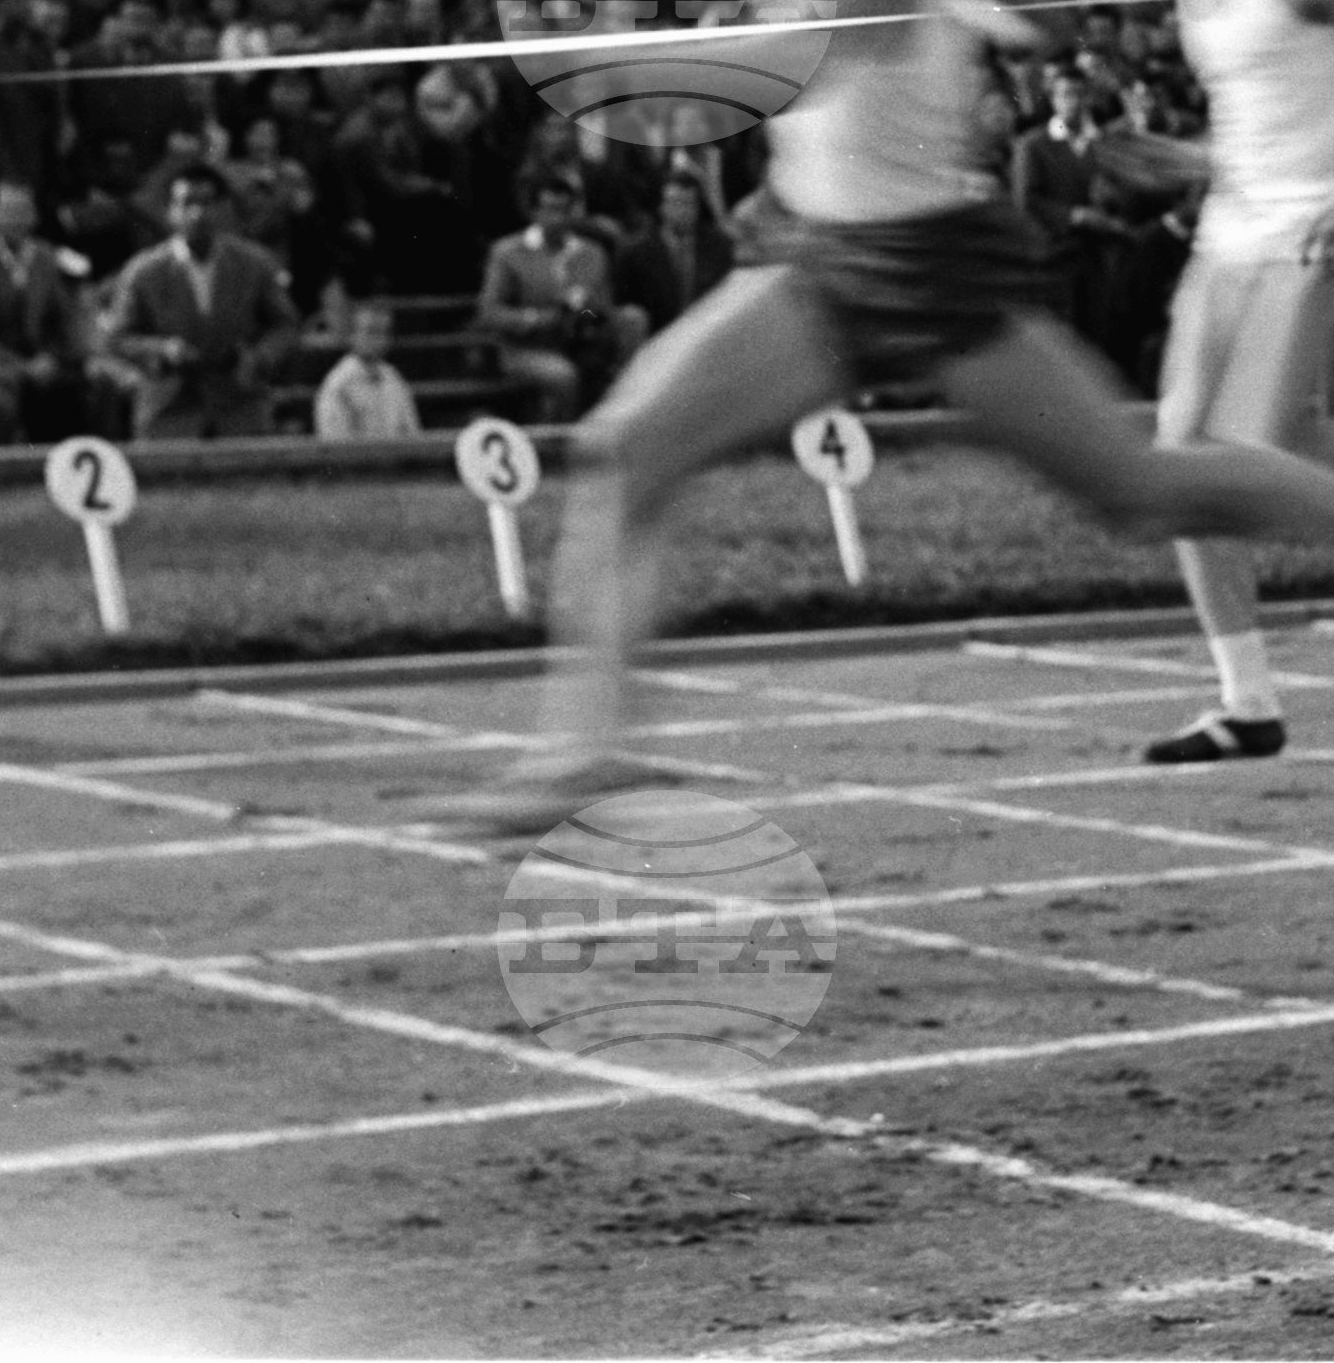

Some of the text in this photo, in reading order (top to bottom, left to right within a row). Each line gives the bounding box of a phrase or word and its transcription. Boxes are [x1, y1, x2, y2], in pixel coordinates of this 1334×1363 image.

[481, 431, 519, 494] 3
[818, 417, 847, 472] 4
[74, 448, 112, 512] 2
